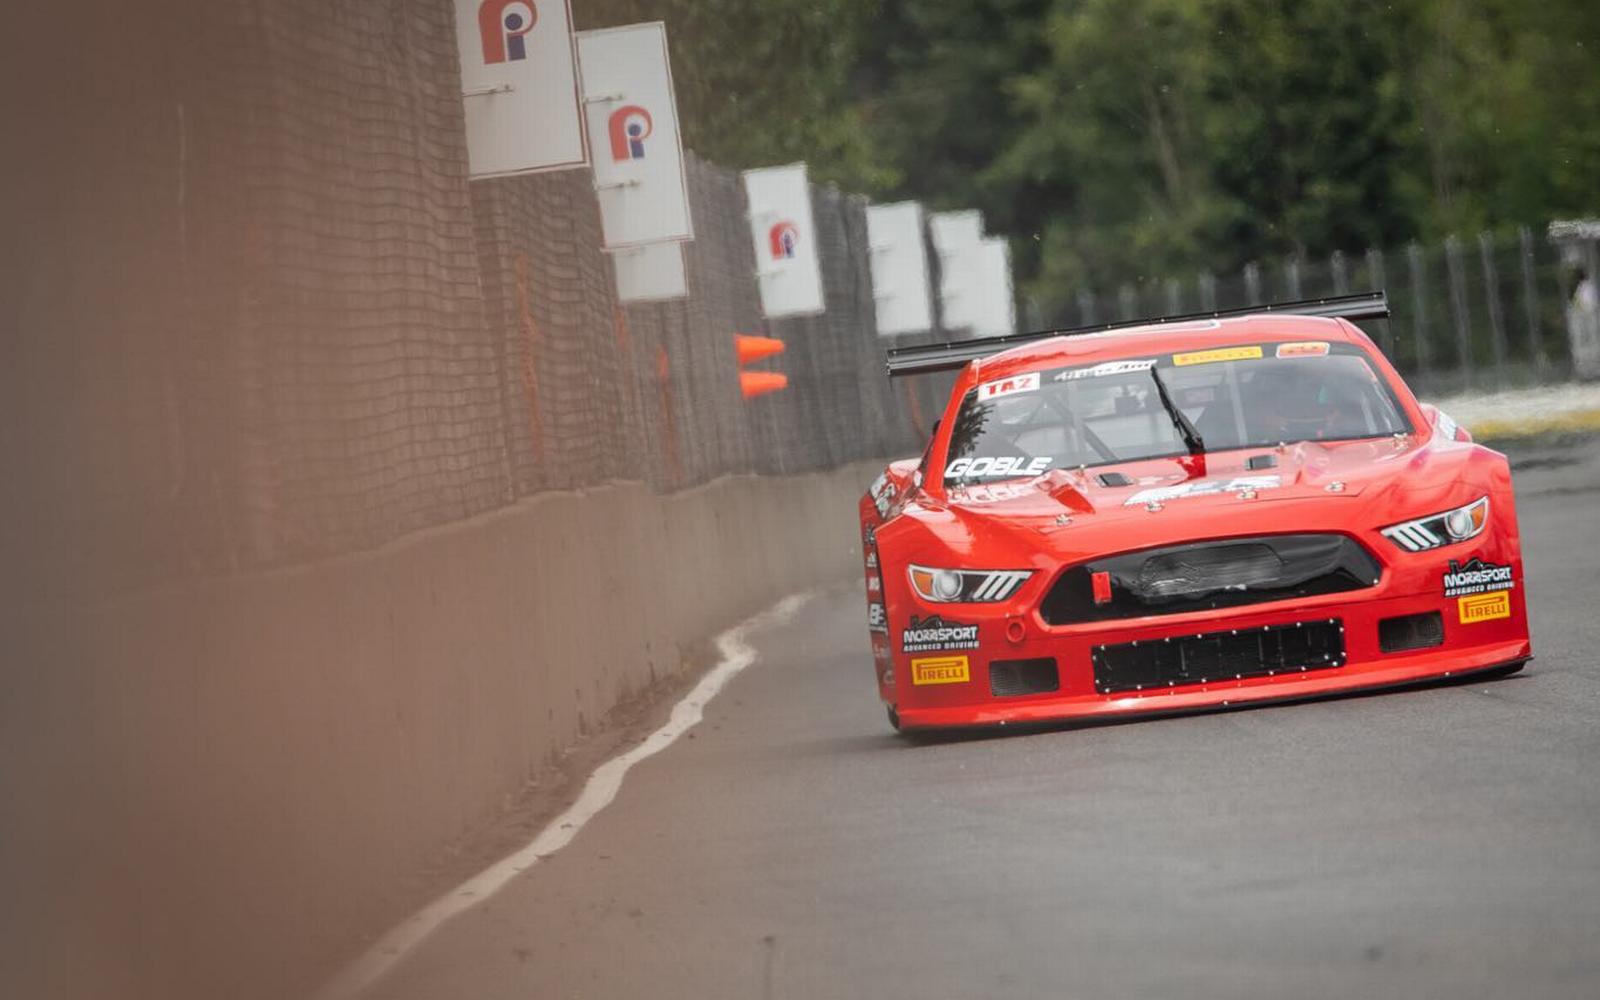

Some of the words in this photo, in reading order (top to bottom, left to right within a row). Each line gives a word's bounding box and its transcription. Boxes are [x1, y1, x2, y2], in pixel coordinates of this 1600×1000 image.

[986, 377, 1032, 396] TA2
[944, 456, 1053, 479] GOBLE
[1444, 567, 1512, 588] MORRISPORT
[1445, 585, 1485, 597] ADVANCED
[1463, 595, 1506, 619] PIRELLI
[903, 625, 978, 643] MORRISPORT
[903, 643, 942, 652] ADVANCED
[944, 640, 980, 650] DRIVING
[916, 660, 964, 681] PIRELLI
